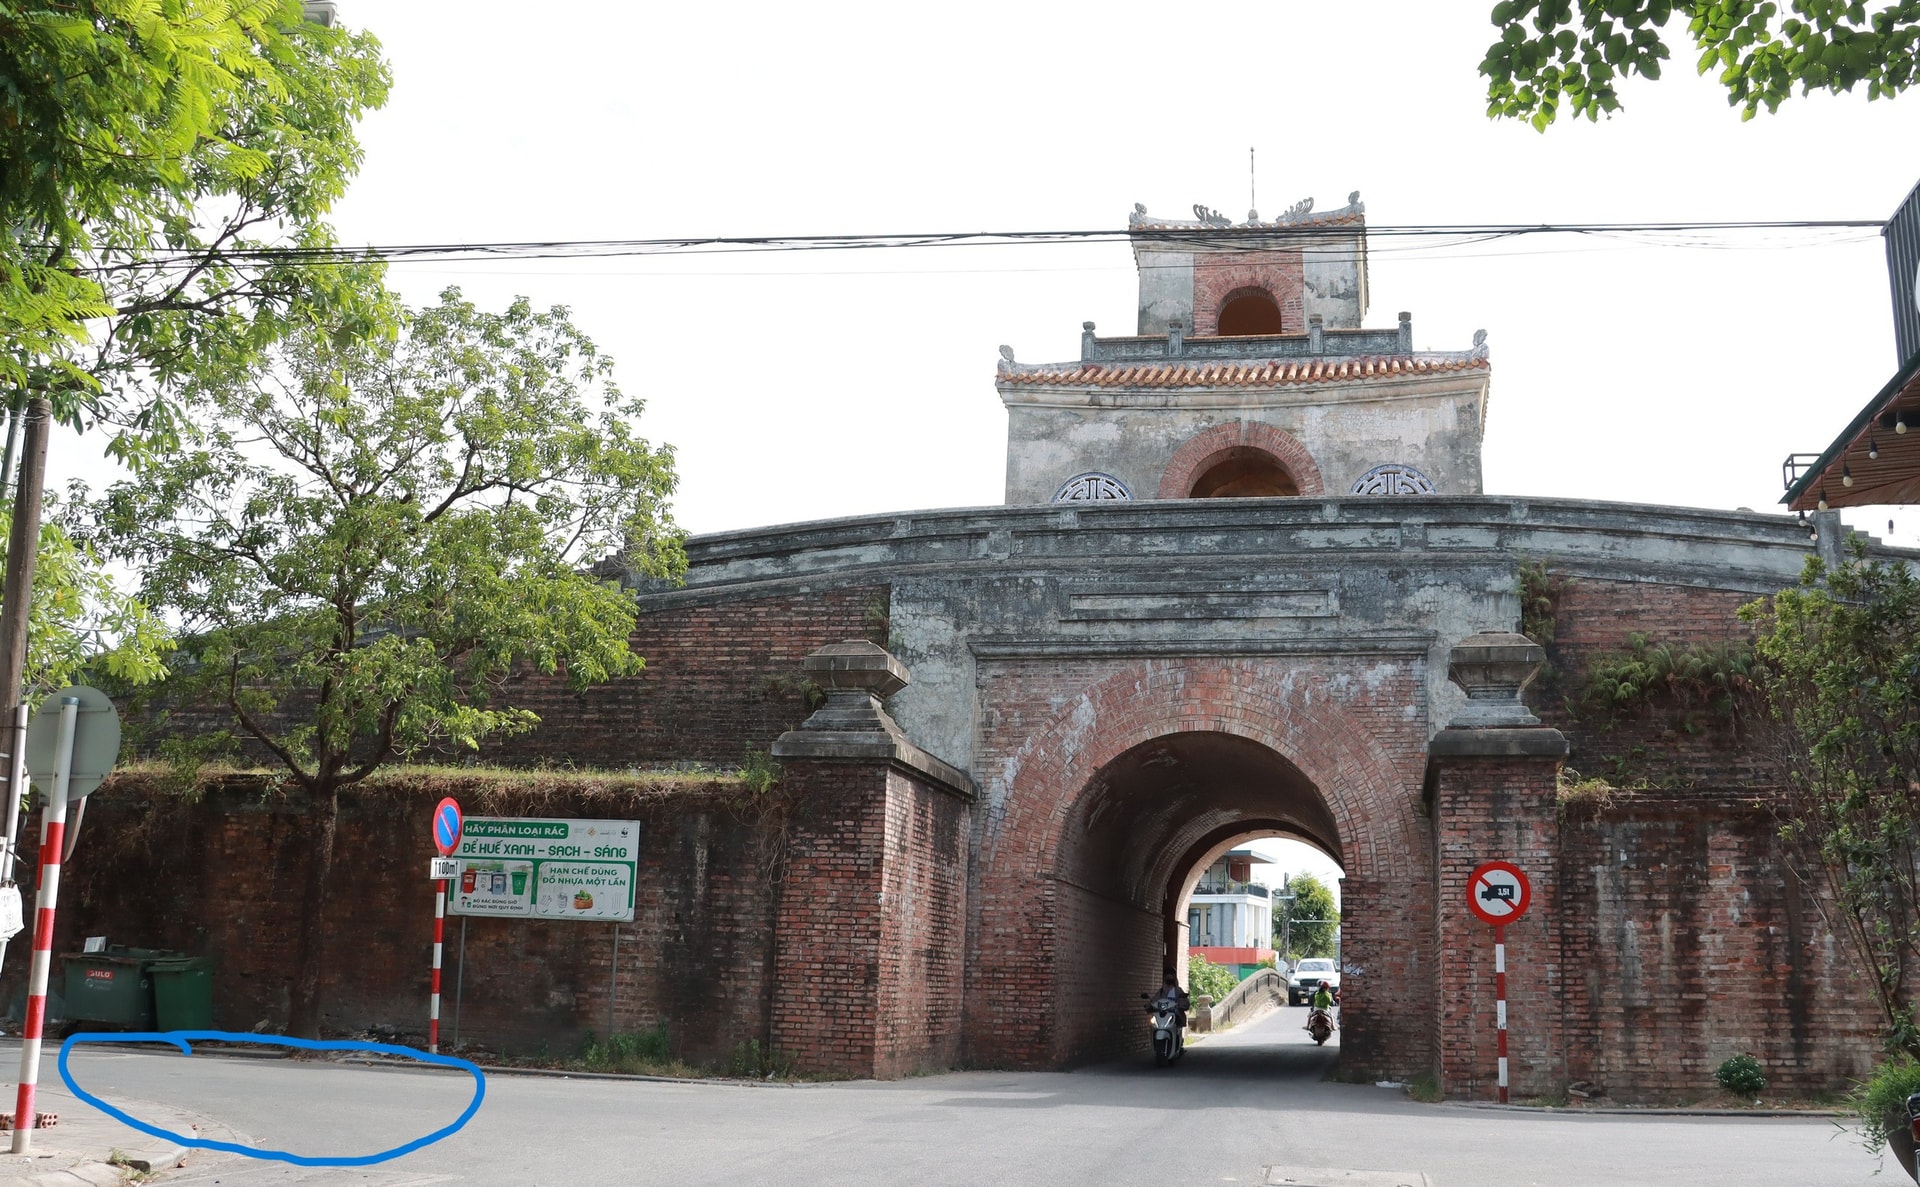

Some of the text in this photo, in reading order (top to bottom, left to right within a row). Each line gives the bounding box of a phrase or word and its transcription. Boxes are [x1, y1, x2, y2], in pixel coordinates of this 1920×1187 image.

[465, 824, 485, 833] HÃY
[487, 825, 516, 834] PHÂN
[518, 827, 542, 837] LOẠI
[544, 826, 565, 836] RÁC
[463, 838, 478, 853] ĐỂ
[479, 840, 503, 854] HUẾ
[503, 844, 535, 855] XANH
[548, 845, 581, 858] SẠCH
[594, 845, 627, 858] SÁNG
[550, 867, 569, 876] HẠN
[571, 866, 590, 875] CHẾ
[558, 878, 584, 886] NHỰA
[586, 877, 606, 887] MỘT
